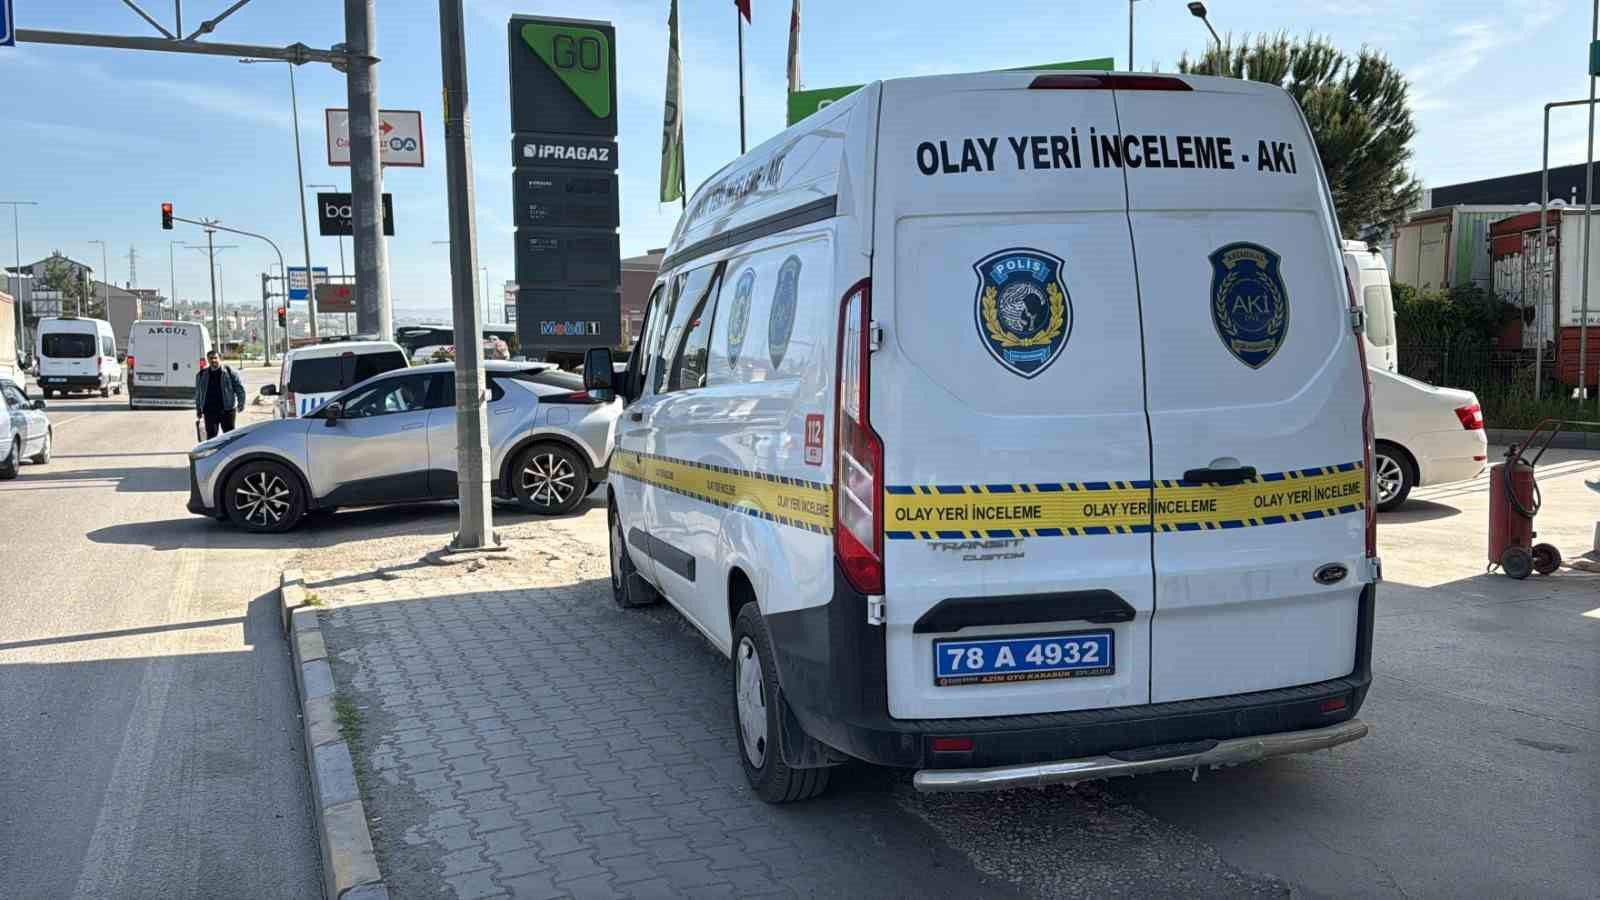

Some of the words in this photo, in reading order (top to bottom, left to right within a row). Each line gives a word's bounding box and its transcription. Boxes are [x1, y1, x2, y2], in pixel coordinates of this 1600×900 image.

[553, 33, 602, 71] GO
[916, 138, 999, 176] OLAY
[1008, 127, 1082, 170] YERİ
[1090, 126, 1235, 170] İNCELEME
[540, 320, 585, 336] Mobil
[808, 420, 821, 443] 112
[1253, 494, 1286, 508] OLAY
[1287, 487, 1313, 505] YERİ
[1313, 480, 1361, 503] İNCELEME
[895, 506, 933, 521] OLAY
[936, 505, 969, 520] YERİ
[972, 503, 1042, 520] İNCELEME
[1083, 503, 1117, 516] OLAY
[1120, 501, 1150, 515] YERİ
[1153, 499, 1217, 514] İNCELEME
[926, 538, 1024, 551] TRANSIT
[963, 552, 1025, 561] CUSTOM
[947, 647, 985, 670] 78
[994, 646, 1017, 668] A
[1025, 641, 1099, 666] 4932
